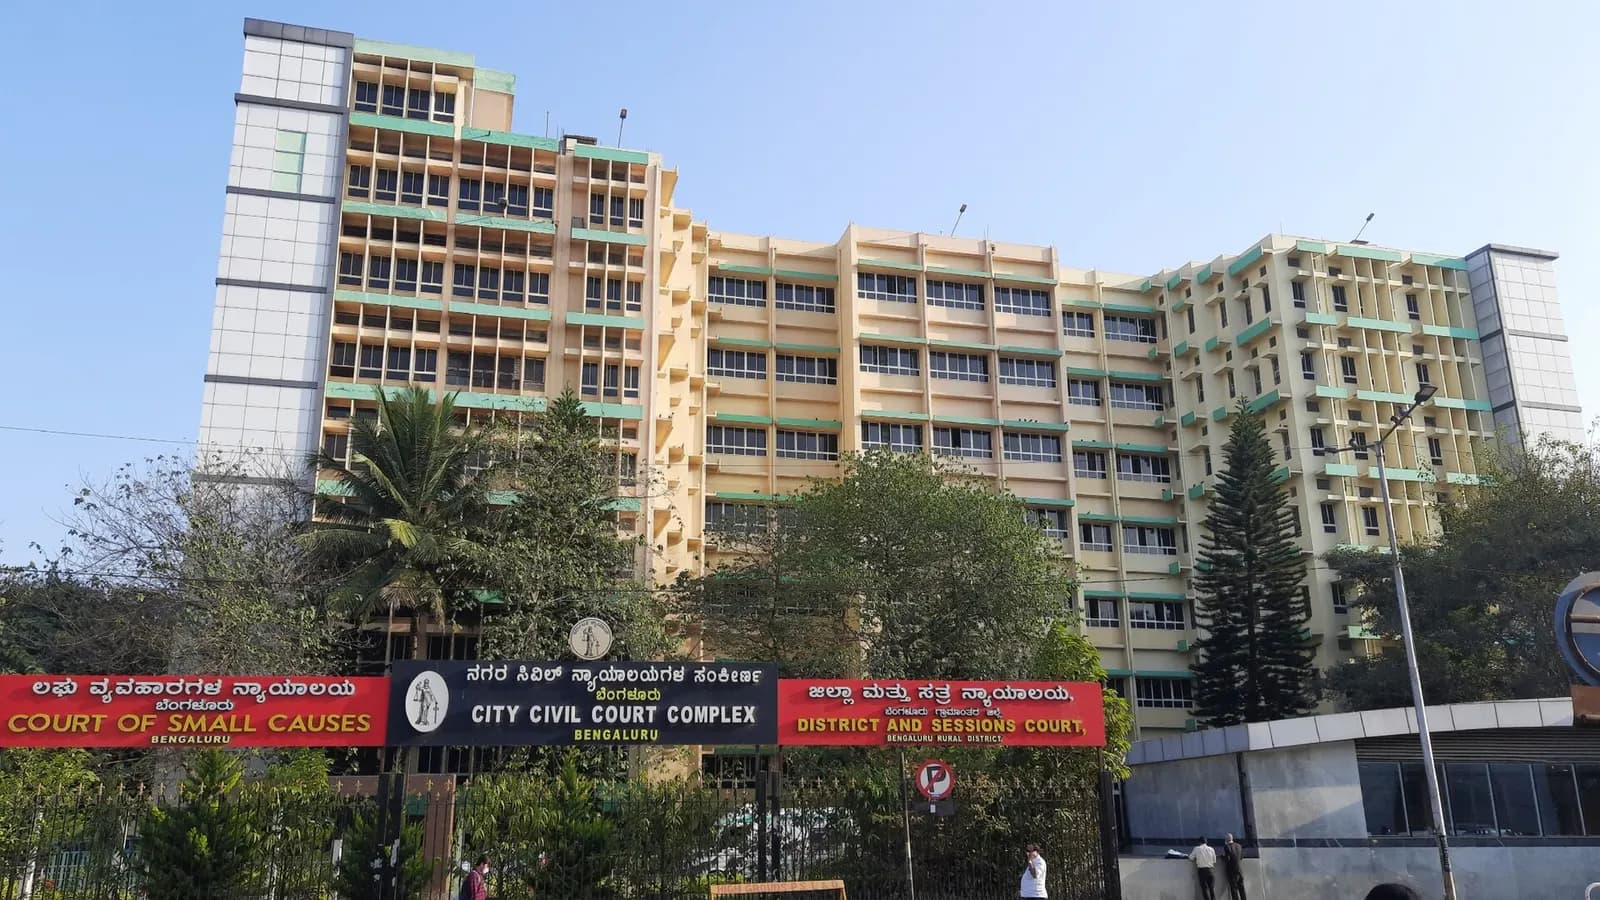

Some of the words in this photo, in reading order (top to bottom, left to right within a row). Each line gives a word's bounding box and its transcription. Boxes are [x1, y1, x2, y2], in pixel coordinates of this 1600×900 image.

[466, 663, 508, 681] ನಗರ
[516, 664, 562, 682] ಸಿವಿಲ್
[571, 665, 685, 692] ನ್ಯಾಯಾಲಯಗಳ
[694, 665, 762, 683] ಸಂಕೀರ್ಣ
[32, 677, 78, 697] ಲಘು
[89, 678, 222, 703] ವ್ಯವಹಾರಗಳ
[232, 679, 355, 703] ನ್ಯಾಯಾಲಯ
[596, 687, 661, 700] ಬೆಂಗಳೂರು
[862, 683, 912, 702] ಮತ್ತು
[918, 683, 951, 705] ಸತ್ರ
[156, 698, 234, 711] ಬೆಂಗಳೂರು
[8, 713, 108, 732] COURT
[117, 714, 157, 732] OF
[167, 714, 257, 732] SMALL
[268, 714, 371, 732] CAUSES
[471, 705, 520, 723] CITY
[529, 705, 581, 723] CIVIL
[591, 705, 657, 723] COURT
[667, 705, 756, 723] COMPLEX
[574, 729, 658, 741] BENGALURU
[797, 718, 880, 732] DISTRICT
[886, 718, 922, 732] AND
[931, 718, 1017, 732] SESSIONS
[1024, 719, 1087, 735] COURT,
[151, 735, 231, 744] BENGALURU
[887, 734, 933, 742] BENGALURU
[926, 765, 947, 793] P
